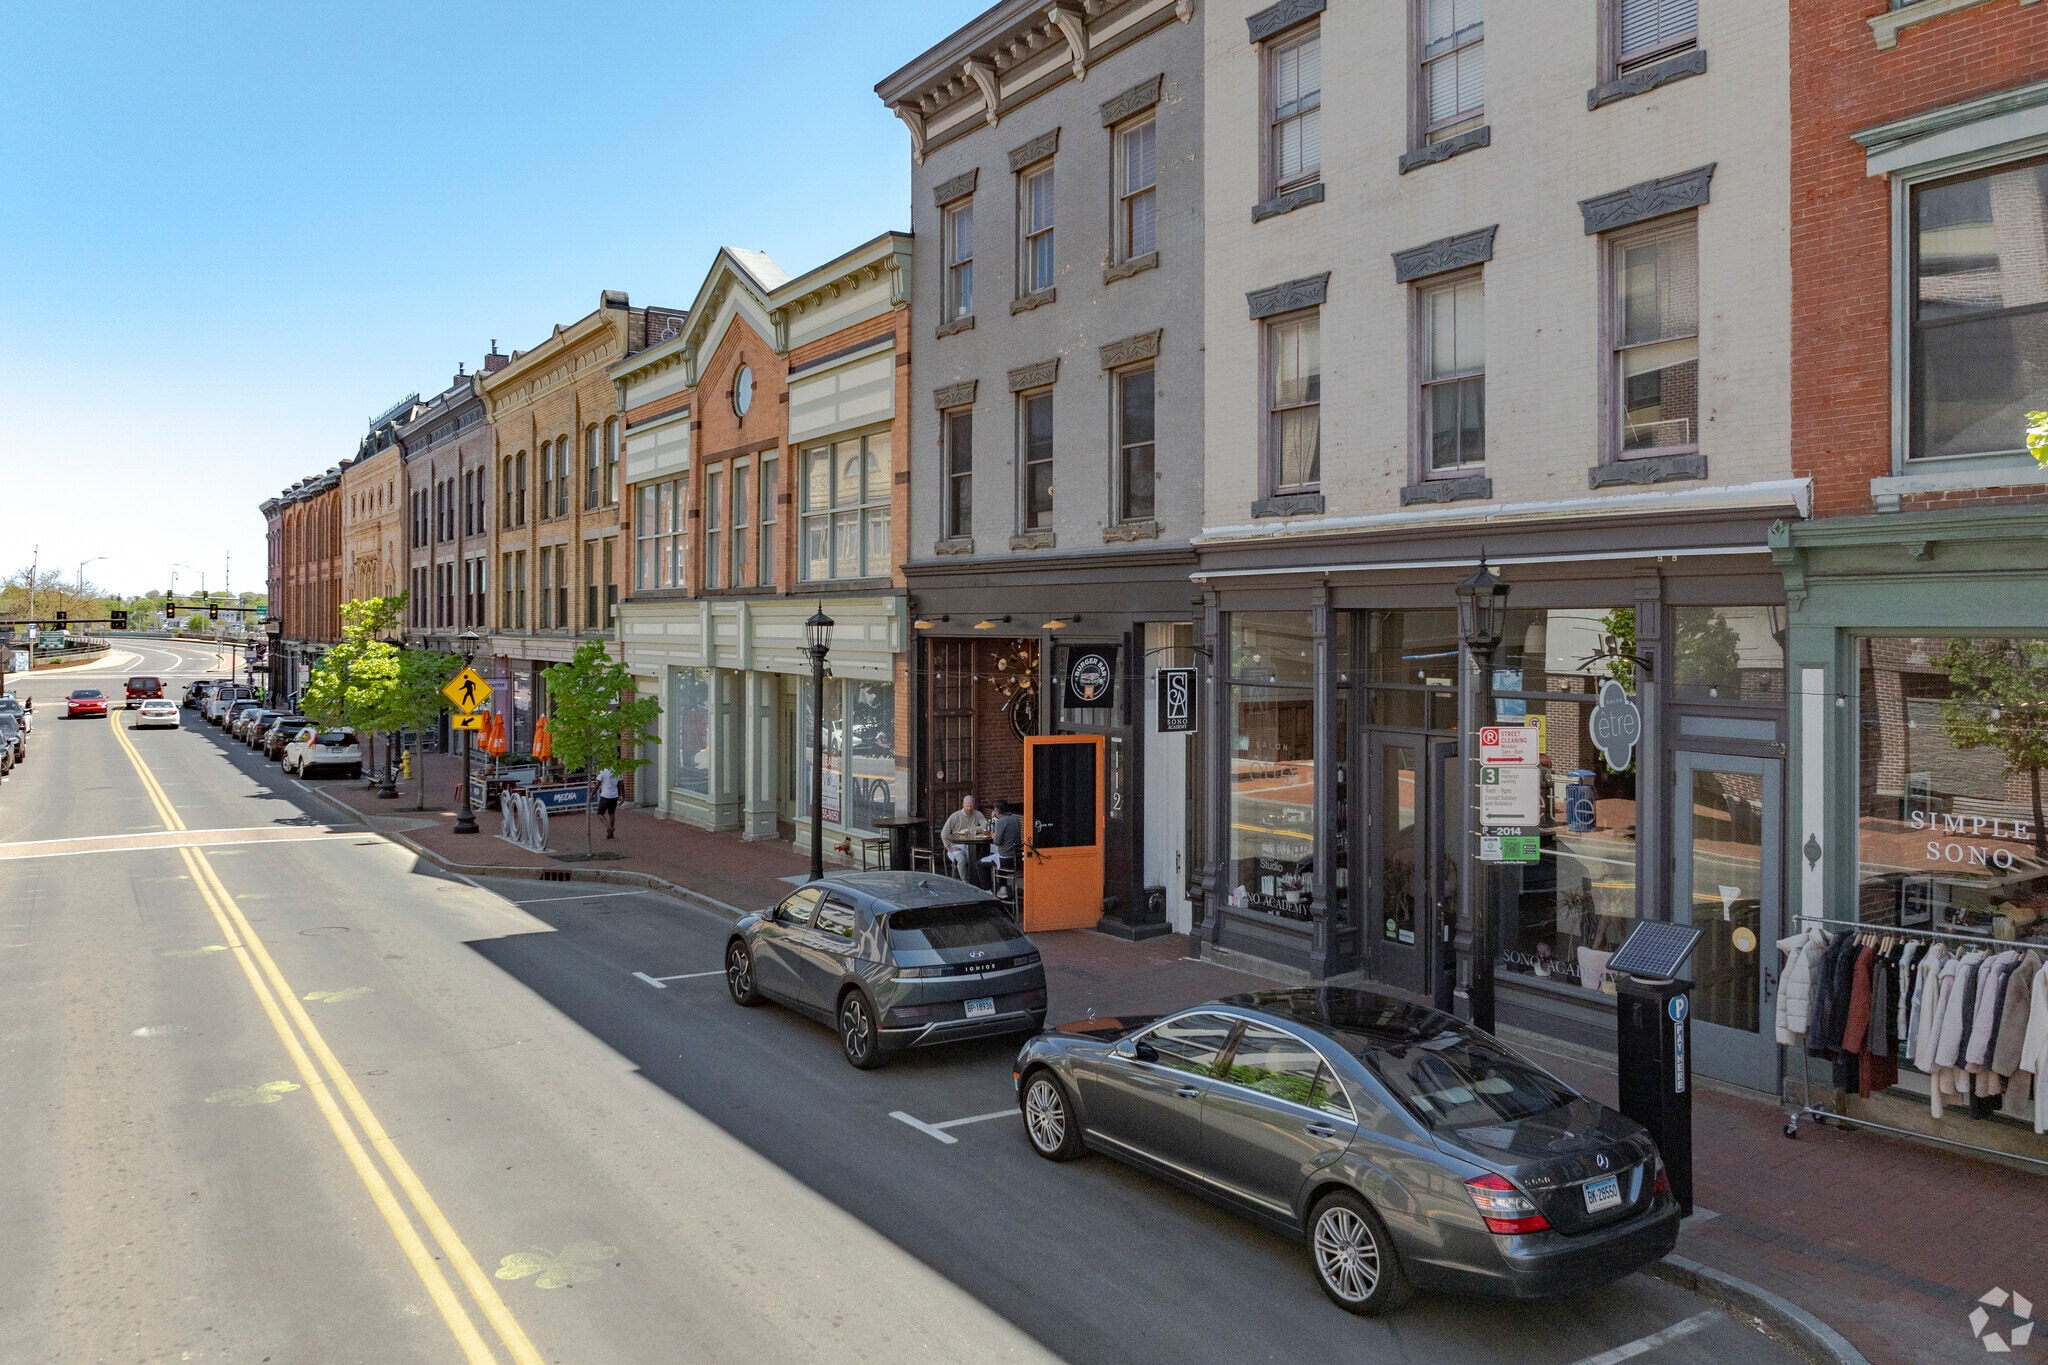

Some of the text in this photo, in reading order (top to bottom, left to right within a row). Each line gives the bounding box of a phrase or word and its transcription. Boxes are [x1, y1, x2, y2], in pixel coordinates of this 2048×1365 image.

[1075, 657, 1107, 677] BURGER BAR
[1598, 711, 1635, 738] être
[1256, 741, 1288, 751] SALON
[1486, 768, 1496, 784] 3
[1910, 810, 2030, 840] SIMPLE
[1926, 841, 2013, 869] SONO
[1260, 859, 1284, 873] Studio
[1263, 895, 1310, 916] ACADEMY
[1503, 948, 1541, 967] SONO
[1675, 999, 1684, 1018] P
